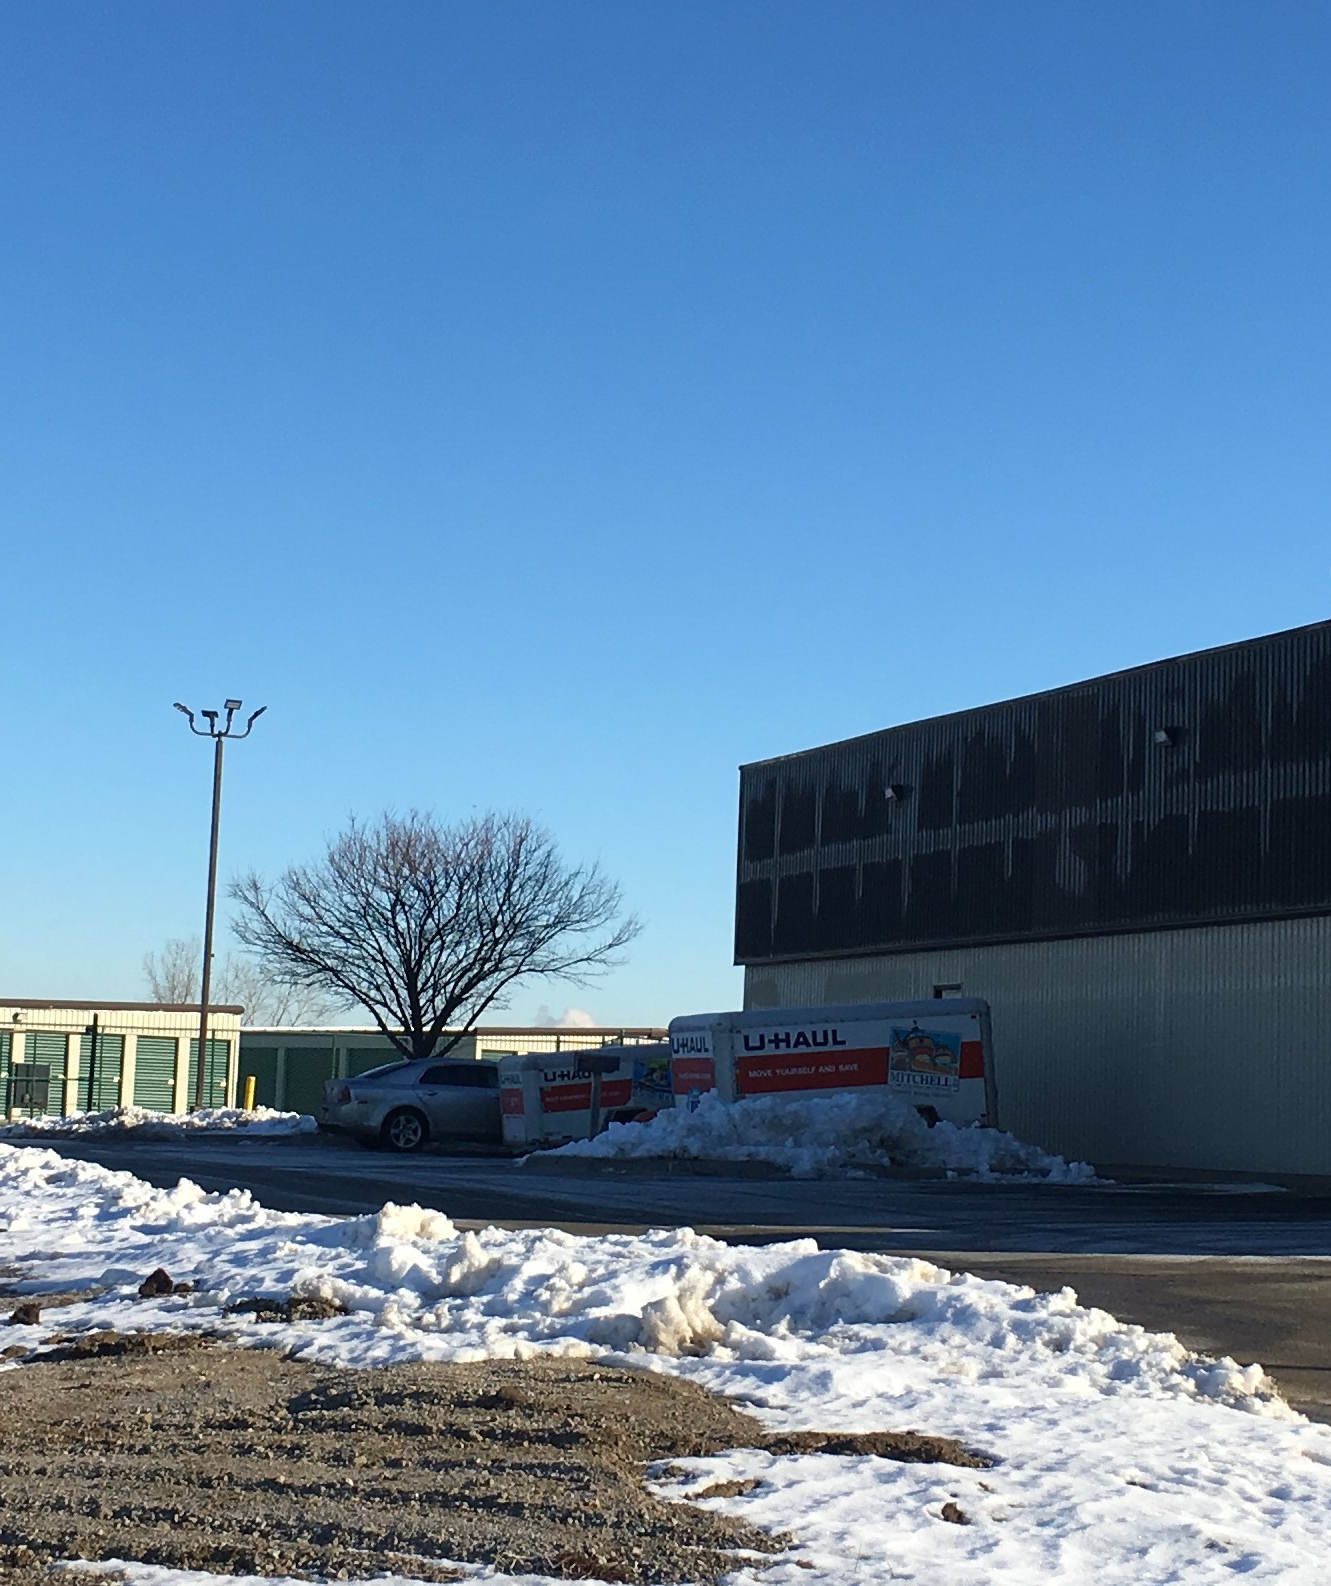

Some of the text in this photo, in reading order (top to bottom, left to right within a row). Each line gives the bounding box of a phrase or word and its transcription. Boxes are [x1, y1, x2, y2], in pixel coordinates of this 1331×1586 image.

[743, 1029, 847, 1052] U-HAUL
[543, 1070, 592, 1083] U-HAU
[748, 1063, 859, 1079] MOVE YOURSELF AND SAVE
